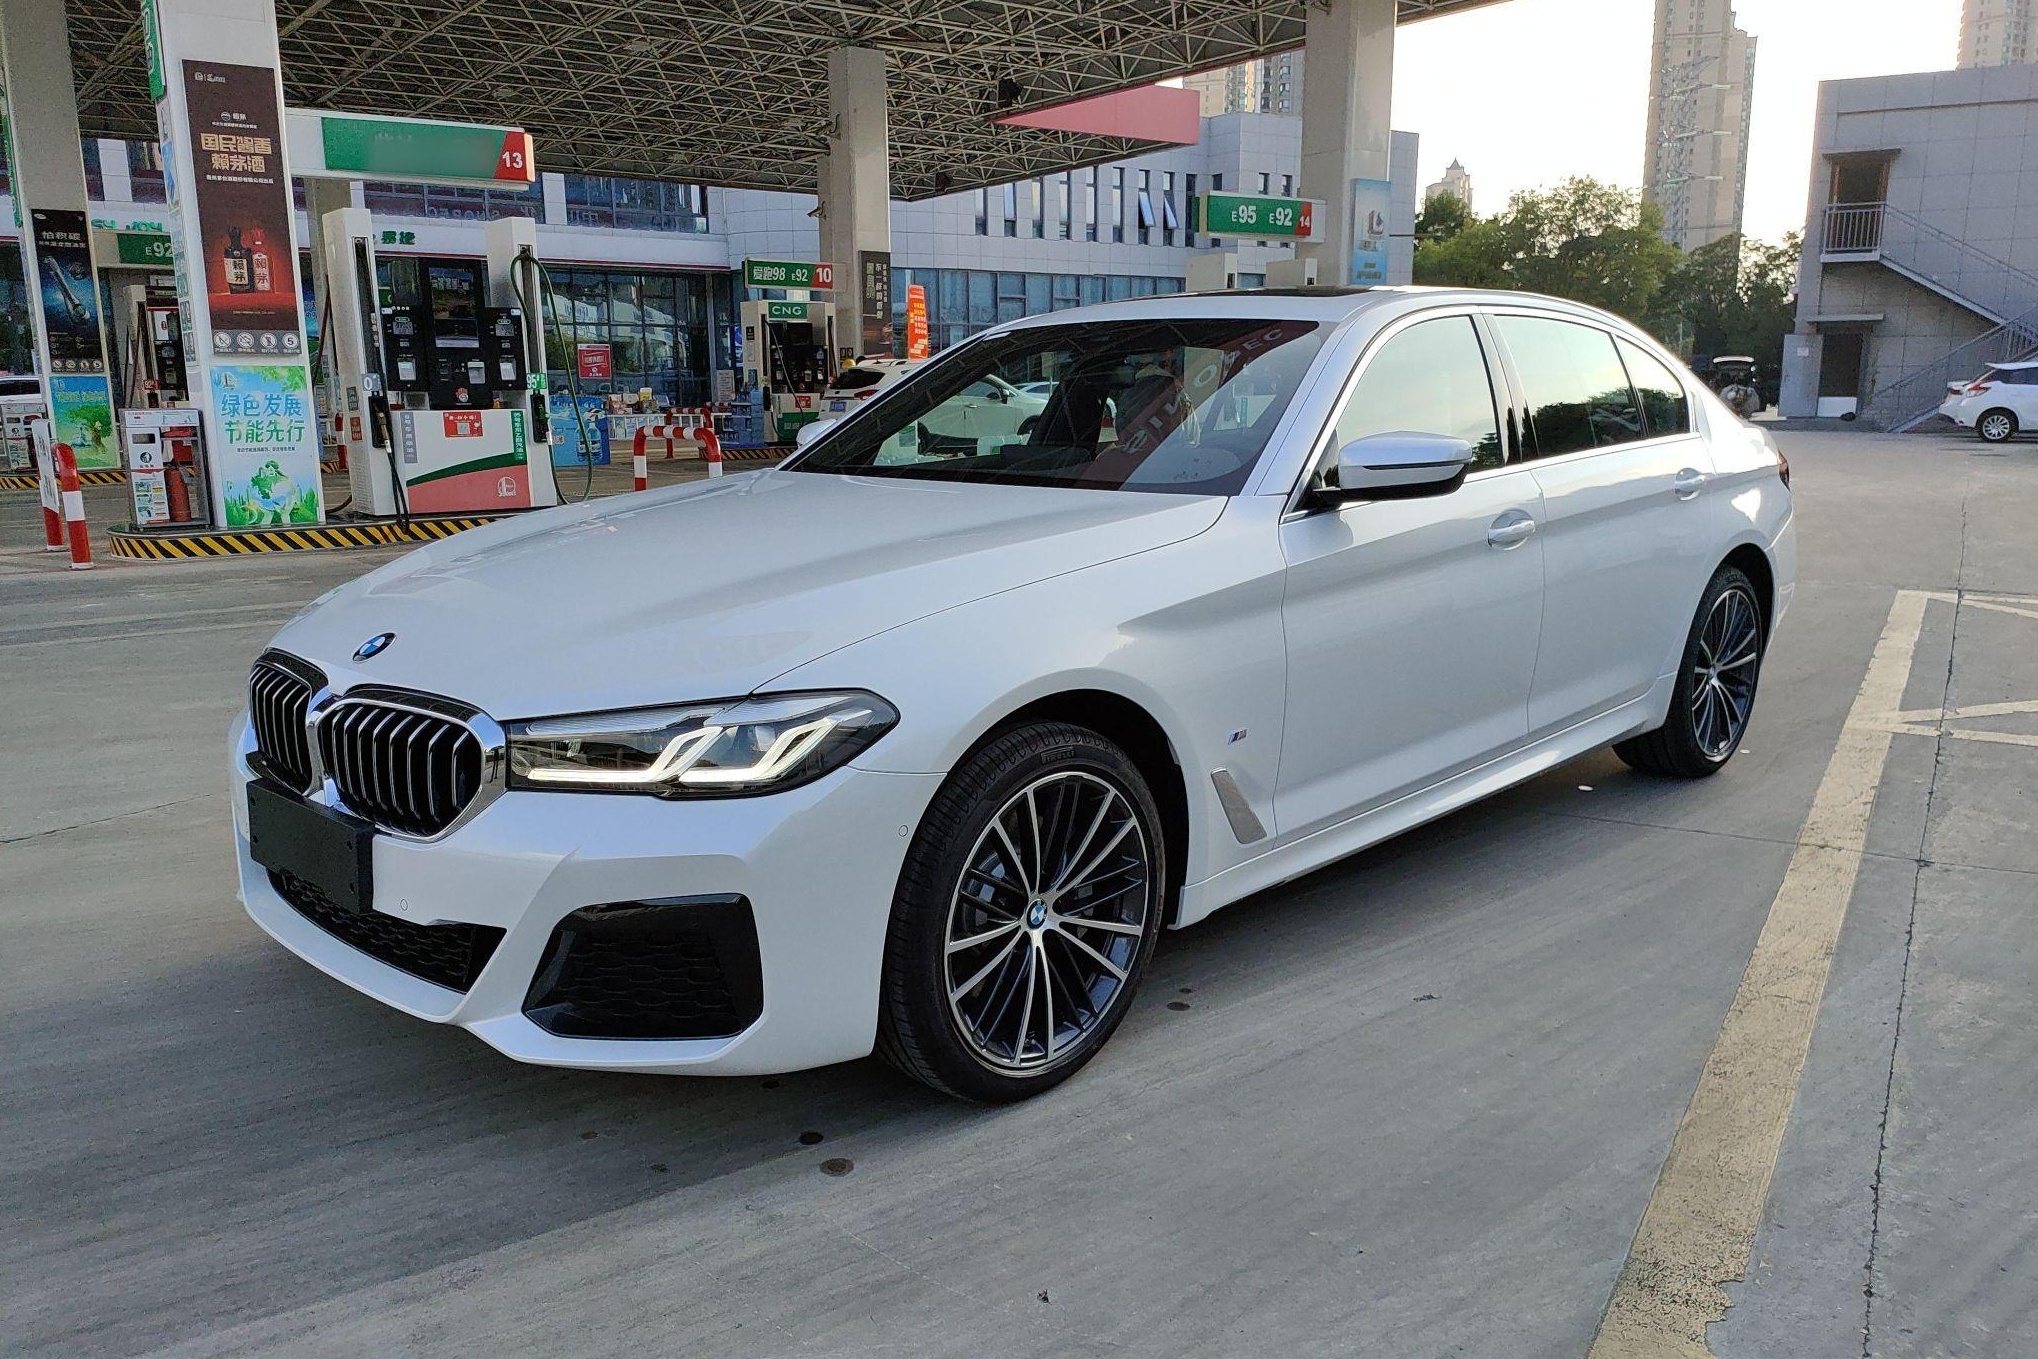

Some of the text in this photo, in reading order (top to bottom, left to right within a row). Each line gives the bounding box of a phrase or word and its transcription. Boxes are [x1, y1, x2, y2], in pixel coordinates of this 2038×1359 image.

[502, 151, 523, 169] 13
[1232, 205, 1310, 228] E95 E92 14
[791, 269, 808, 282] E92
[816, 267, 832, 283] 10
[771, 305, 802, 315] CNG
[287, 337, 294, 346] 5
[221, 393, 302, 417] 绿色发展
[225, 419, 305, 444] 节能先行
